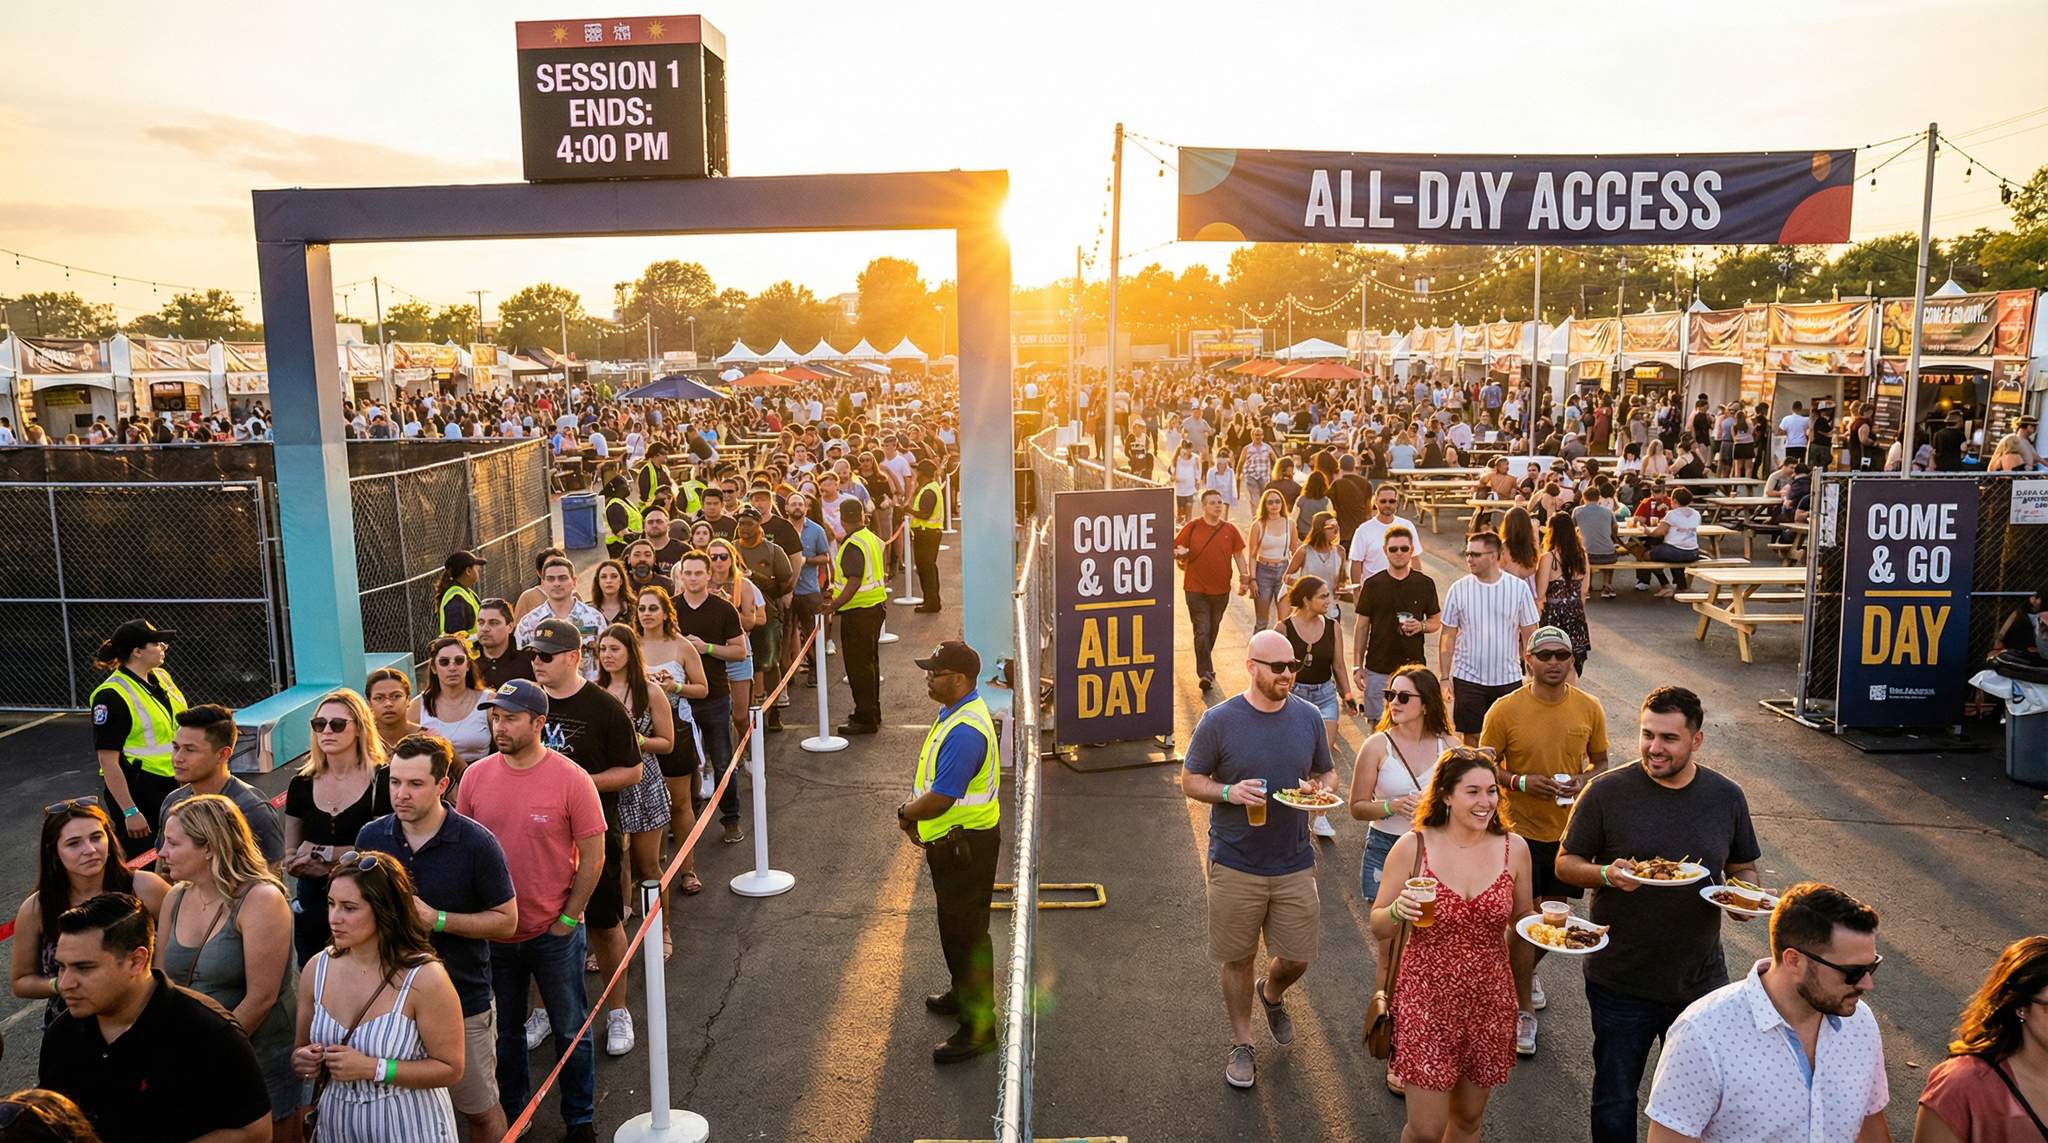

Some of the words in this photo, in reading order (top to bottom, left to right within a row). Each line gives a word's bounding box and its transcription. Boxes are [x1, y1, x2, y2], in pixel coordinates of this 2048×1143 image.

[536, 60, 657, 93] SESSION
[666, 60, 679, 89] 1
[569, 97, 653, 127] ENDS:
[556, 133, 616, 164] 4:00
[625, 131, 669, 161] PM
[1304, 169, 1512, 230] ALL-DAY
[1527, 169, 1723, 231] ACCESS
[1073, 513, 1157, 554] COME
[1867, 503, 1957, 541] COME
[1077, 558, 1103, 597] &
[1113, 555, 1153, 594] GO
[1868, 545, 1895, 584] &
[1907, 545, 1951, 584] GO
[1077, 614, 1155, 669] ALL
[1861, 604, 1951, 665] DAY
[1078, 668, 1155, 719] DAY
